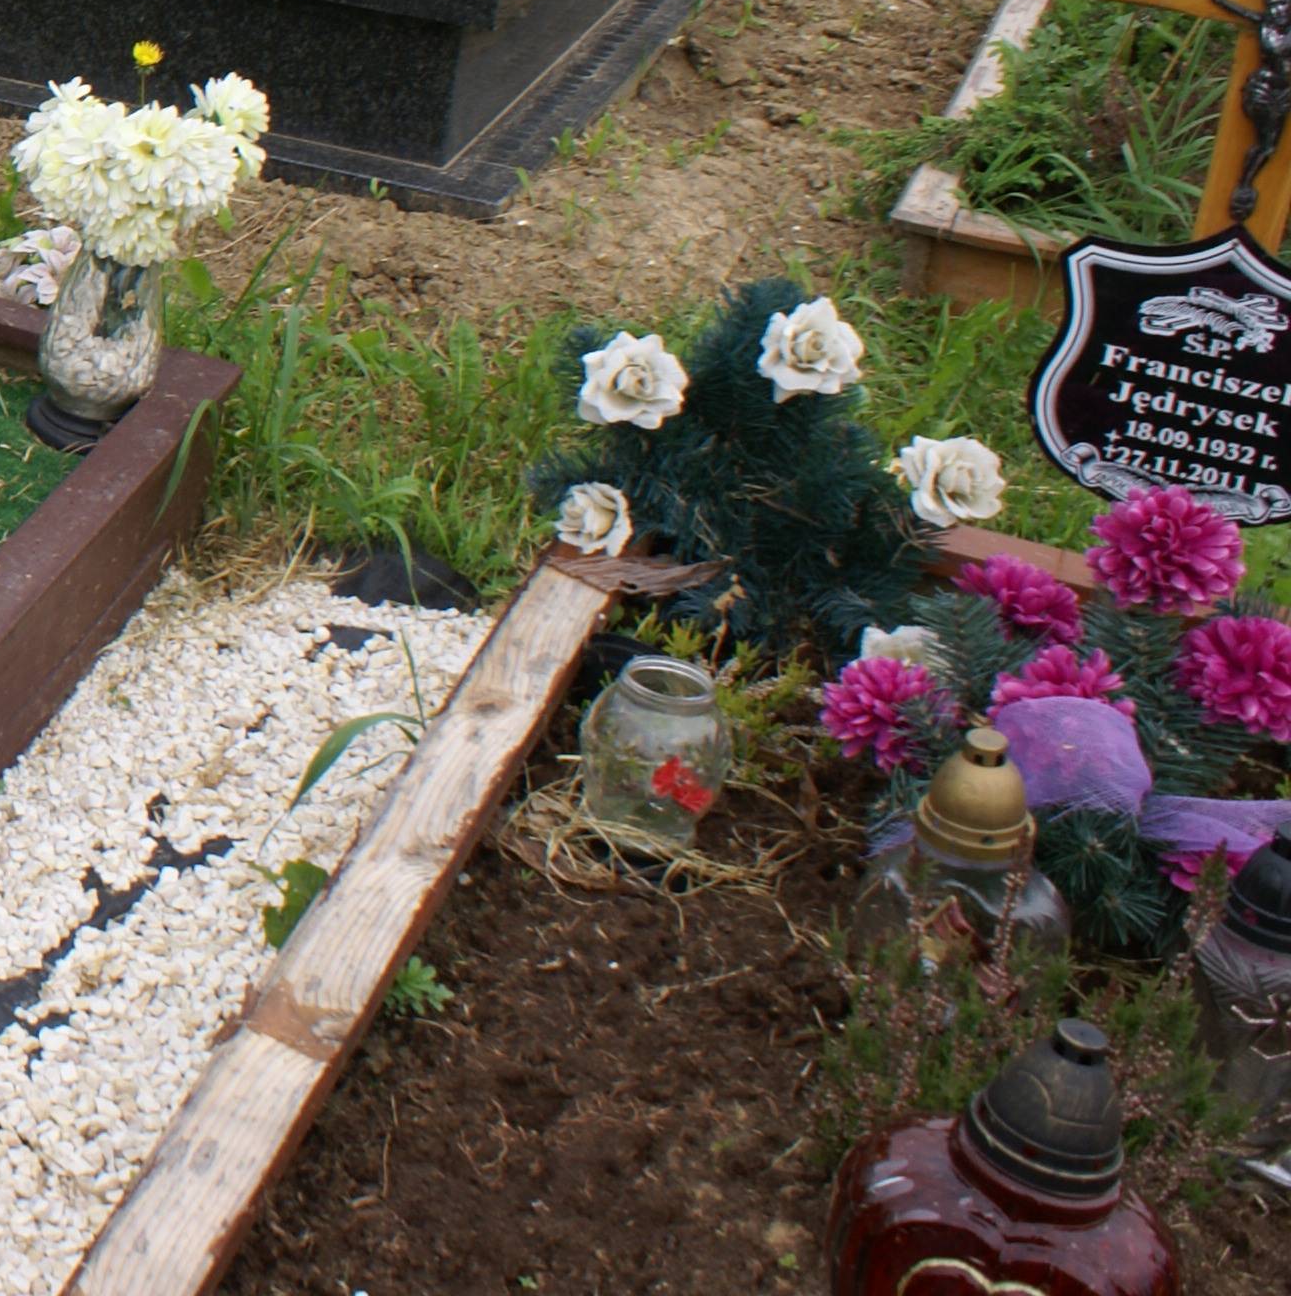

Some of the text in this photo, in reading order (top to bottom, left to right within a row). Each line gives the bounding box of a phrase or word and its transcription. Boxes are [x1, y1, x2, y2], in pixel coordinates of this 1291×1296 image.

[1107, 380, 1281, 439] Jędrysek
[1125, 419, 1255, 466] 18.09.1932
[1117, 445, 1247, 492] 27.11.2011
